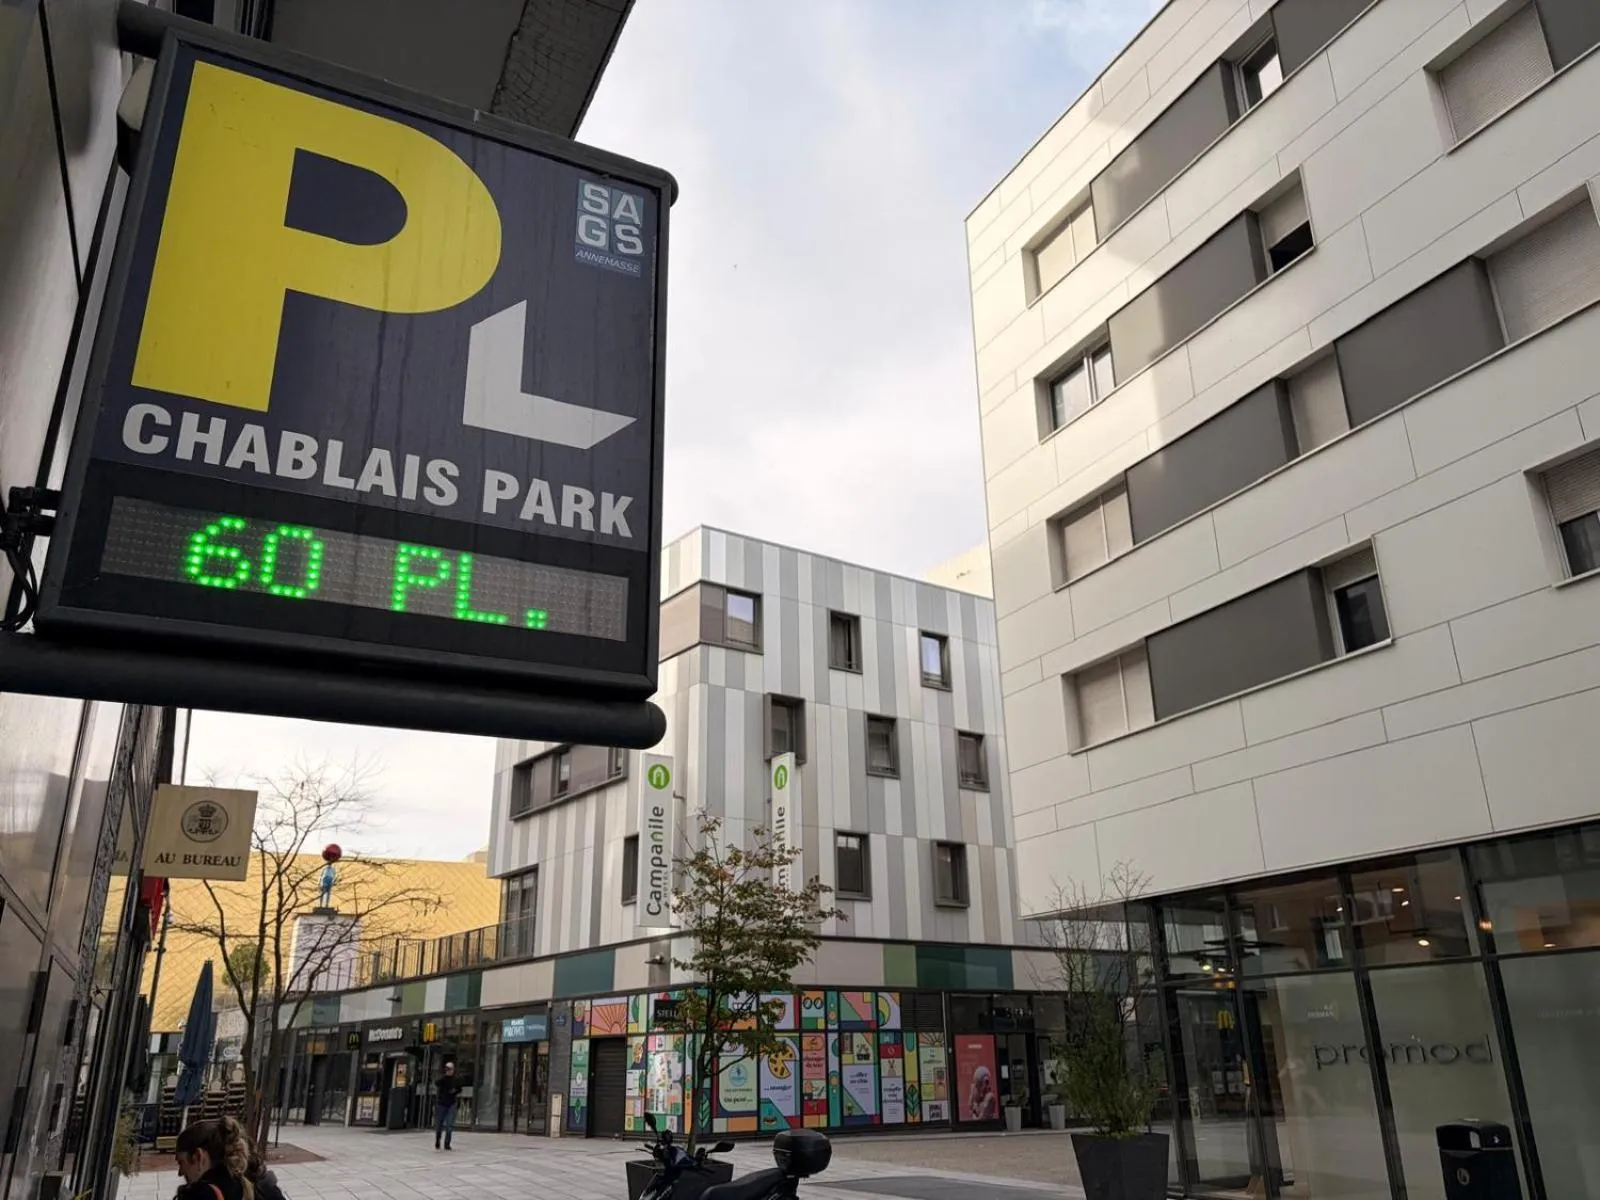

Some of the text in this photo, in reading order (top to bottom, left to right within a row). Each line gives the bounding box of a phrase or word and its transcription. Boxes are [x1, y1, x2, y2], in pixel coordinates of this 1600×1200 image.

[131, 60, 502, 412] P
[575, 249, 641, 273] ANNEMASSE
[122, 402, 635, 539] CHABLAIS PARK
[183, 514, 550, 631] 60 PL.
[154, 852, 242, 867] AU BUREAU
[646, 805, 667, 916] Campanile
